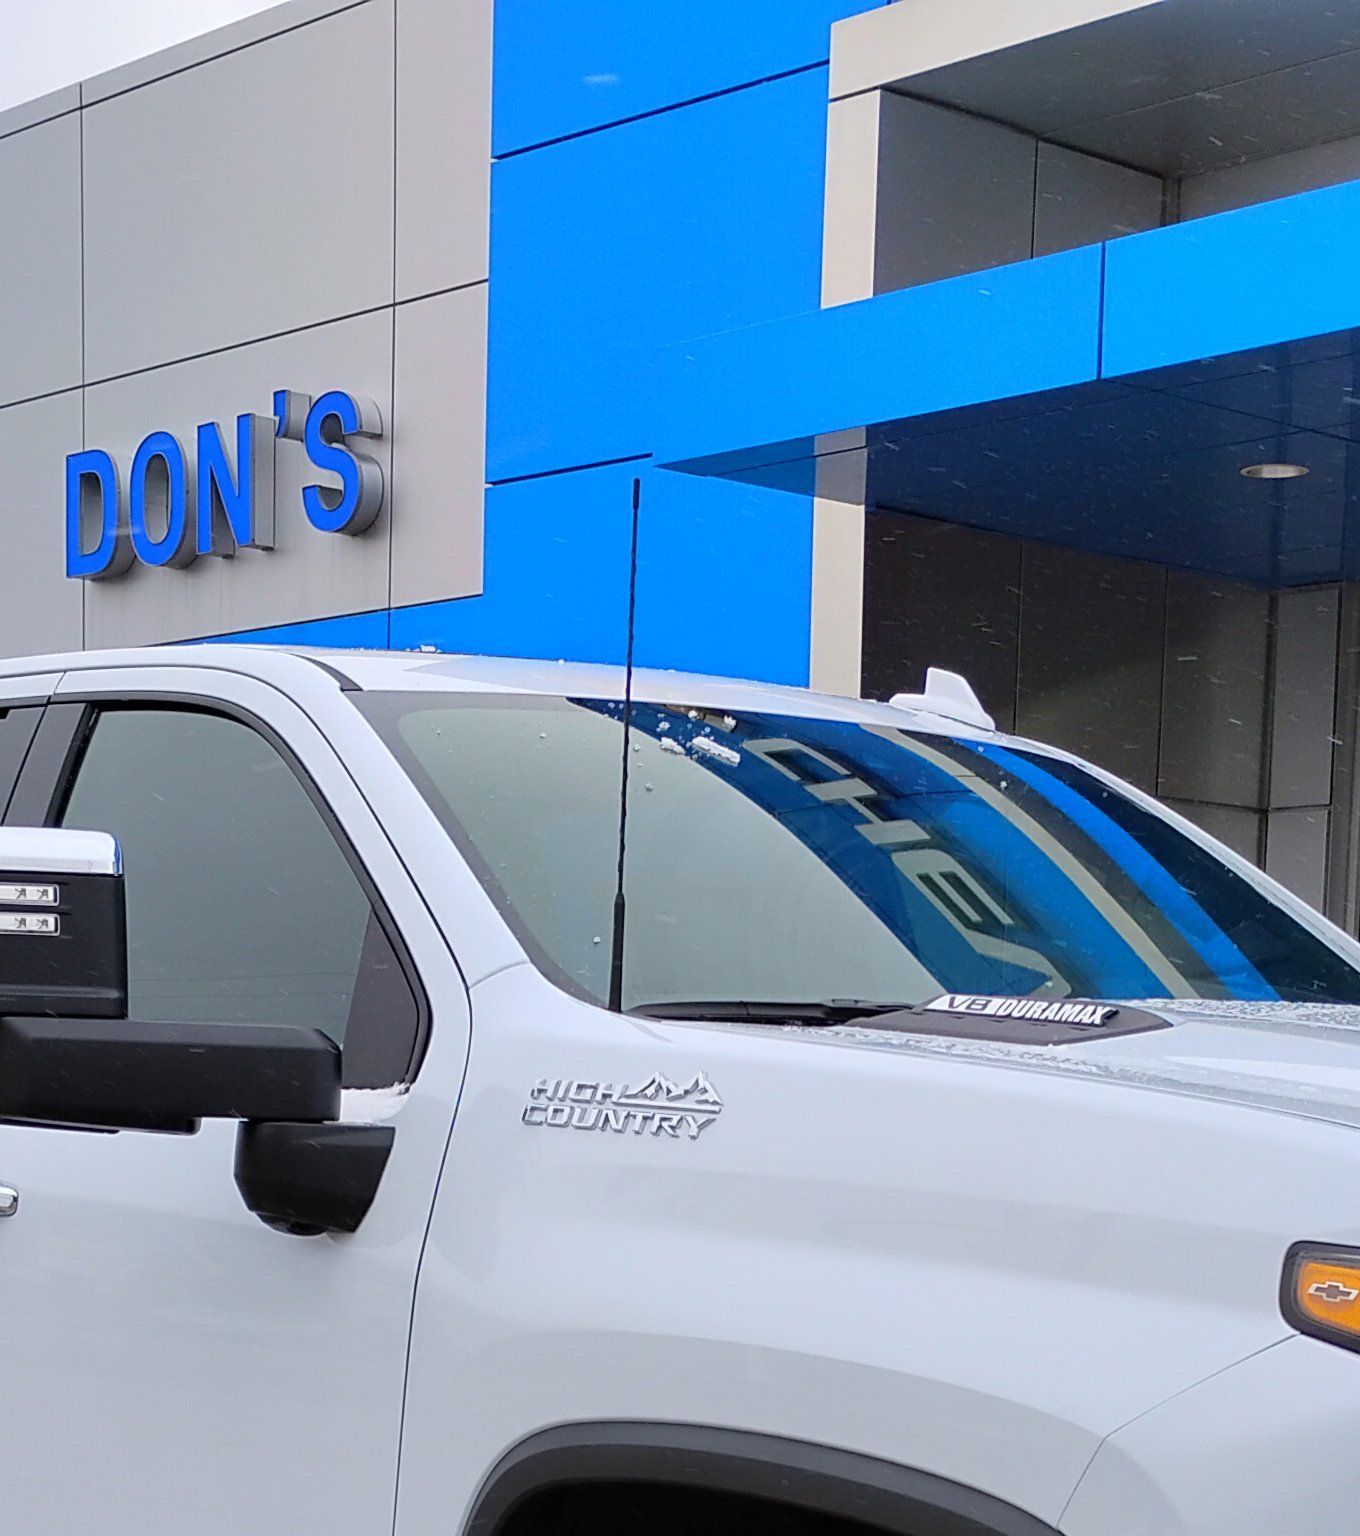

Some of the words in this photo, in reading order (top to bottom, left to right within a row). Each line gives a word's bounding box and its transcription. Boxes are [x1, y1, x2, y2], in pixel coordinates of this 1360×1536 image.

[66, 390, 364, 579] DON'S
[948, 996, 988, 1012] V8
[995, 999, 1111, 1025] DURAMAX
[529, 1079, 628, 1104] HIGH
[521, 1103, 717, 1140] COUNTRY
